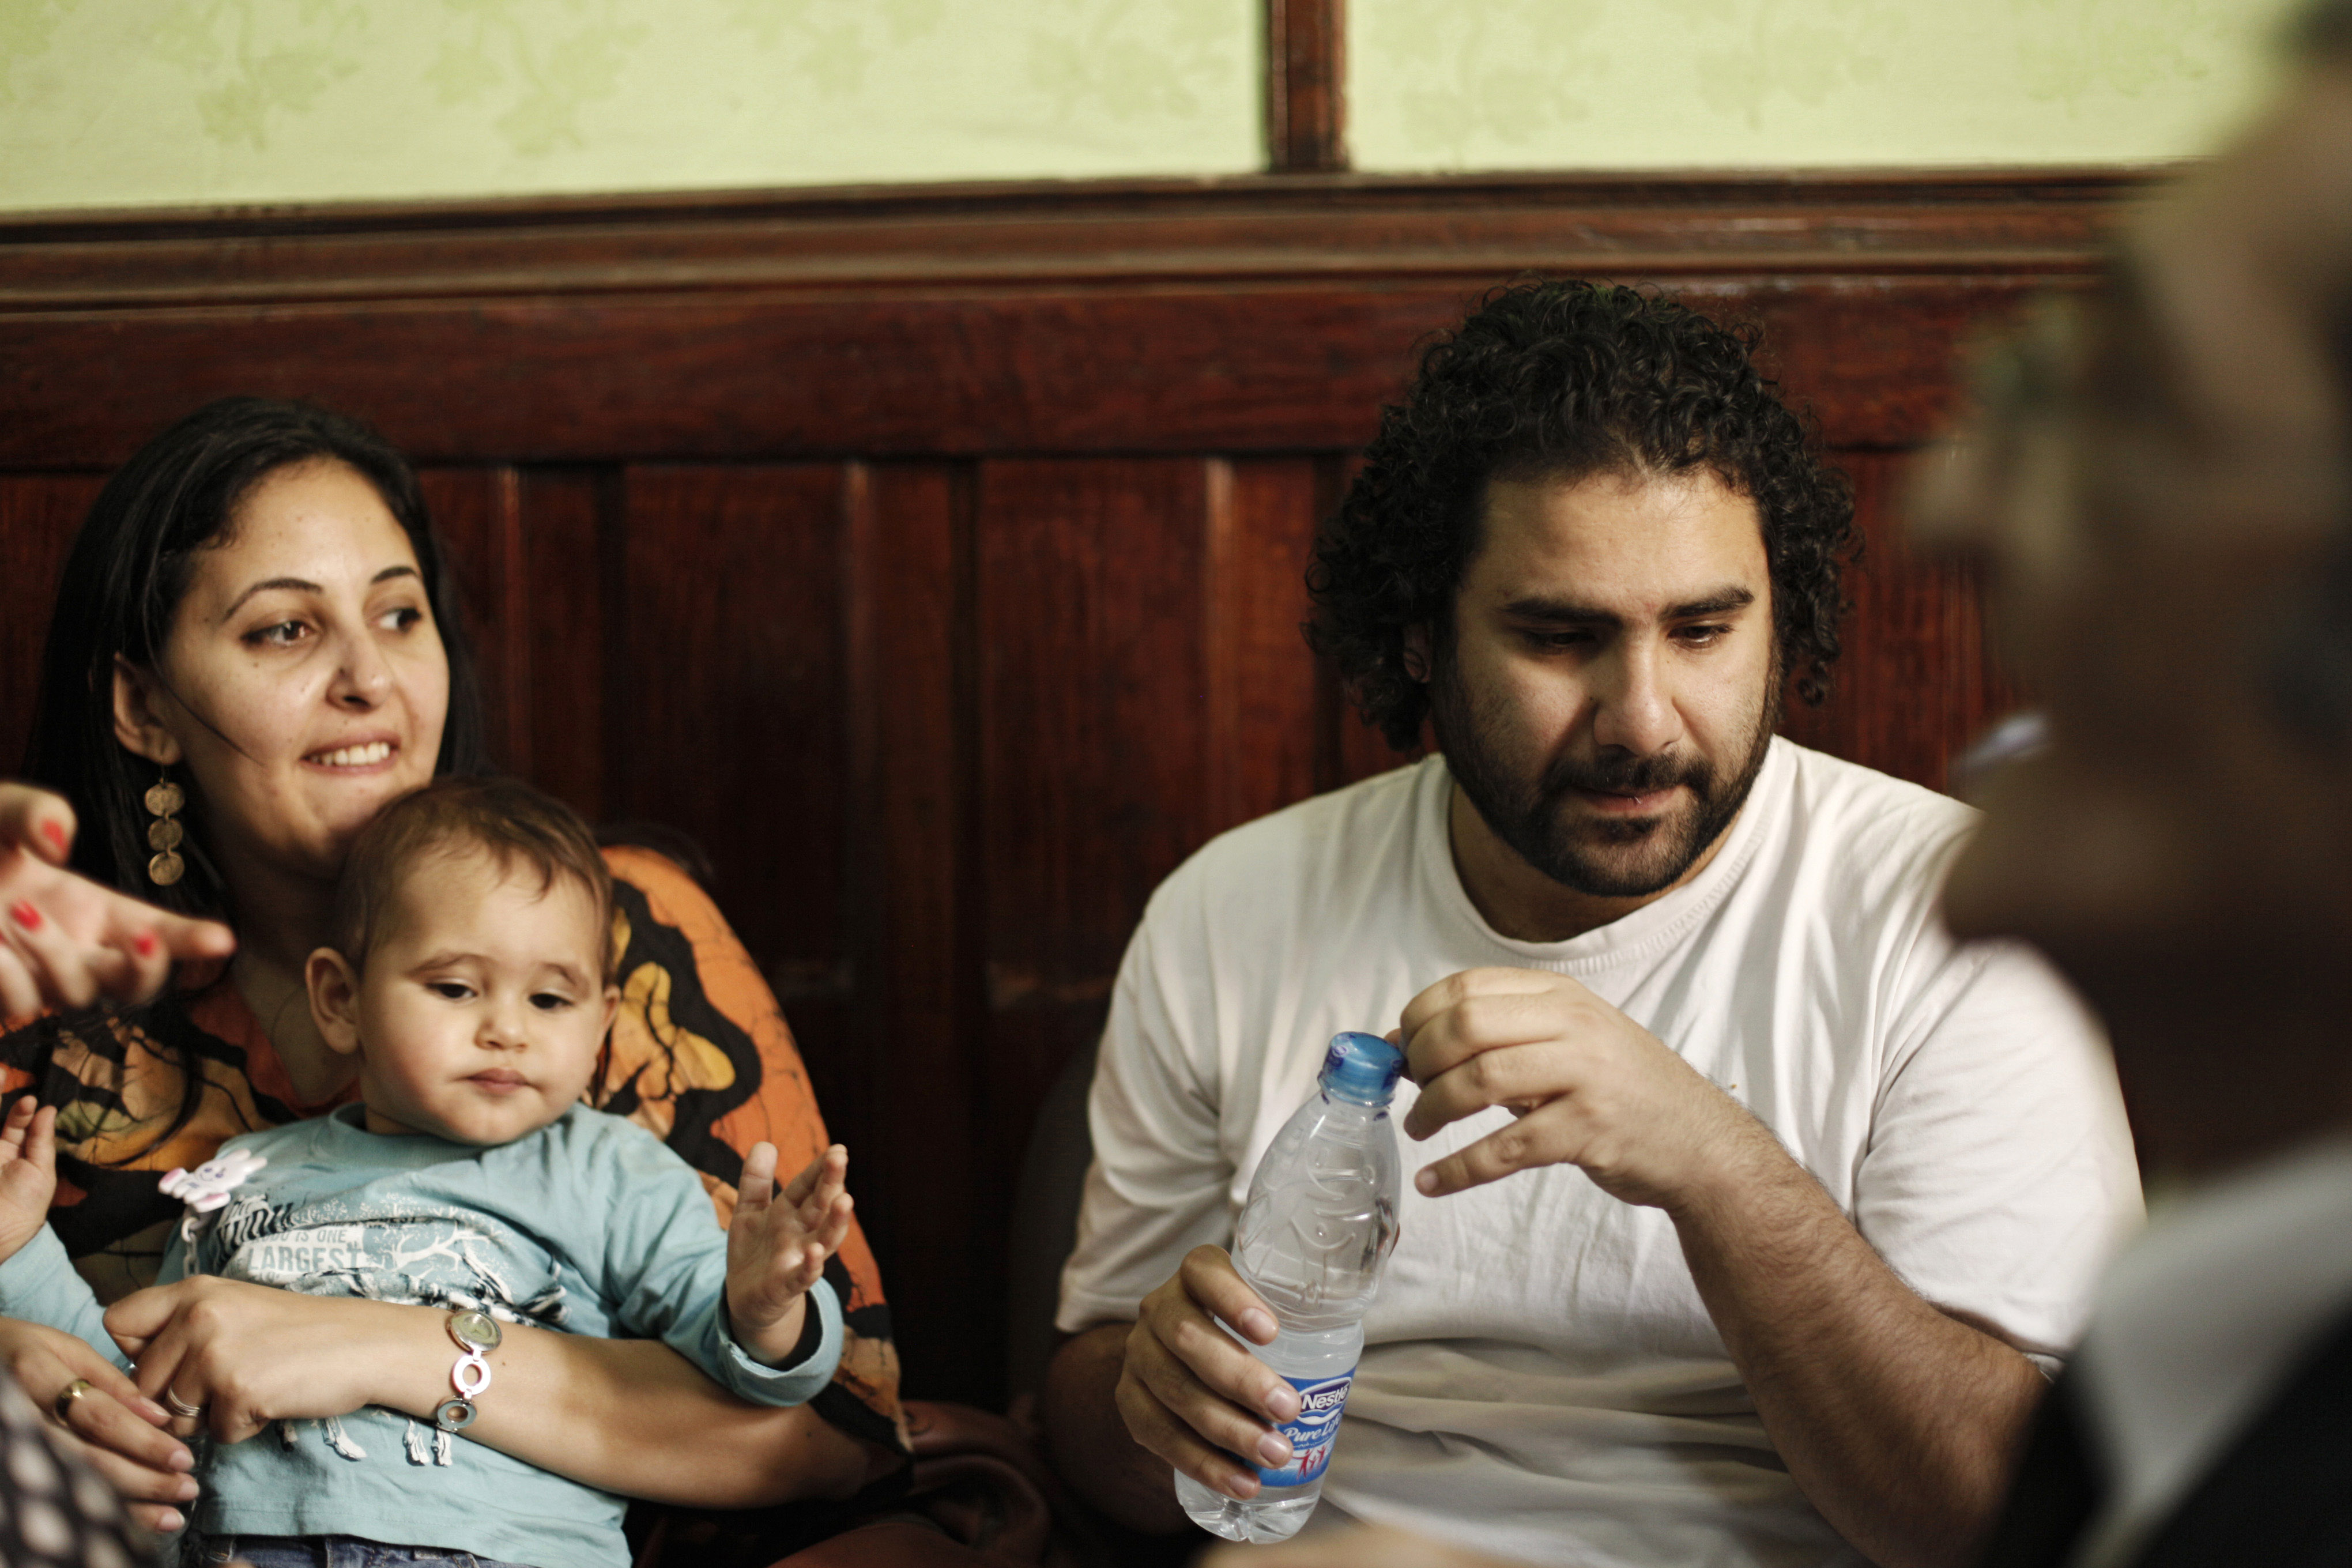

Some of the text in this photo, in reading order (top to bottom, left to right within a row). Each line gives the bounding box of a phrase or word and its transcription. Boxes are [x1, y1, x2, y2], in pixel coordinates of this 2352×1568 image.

[296, 1231, 310, 1242] IS
[317, 1229, 347, 1242] ONE
[248, 1245, 362, 1271] LARGEST
[1284, 1427, 1321, 1442] Pure
